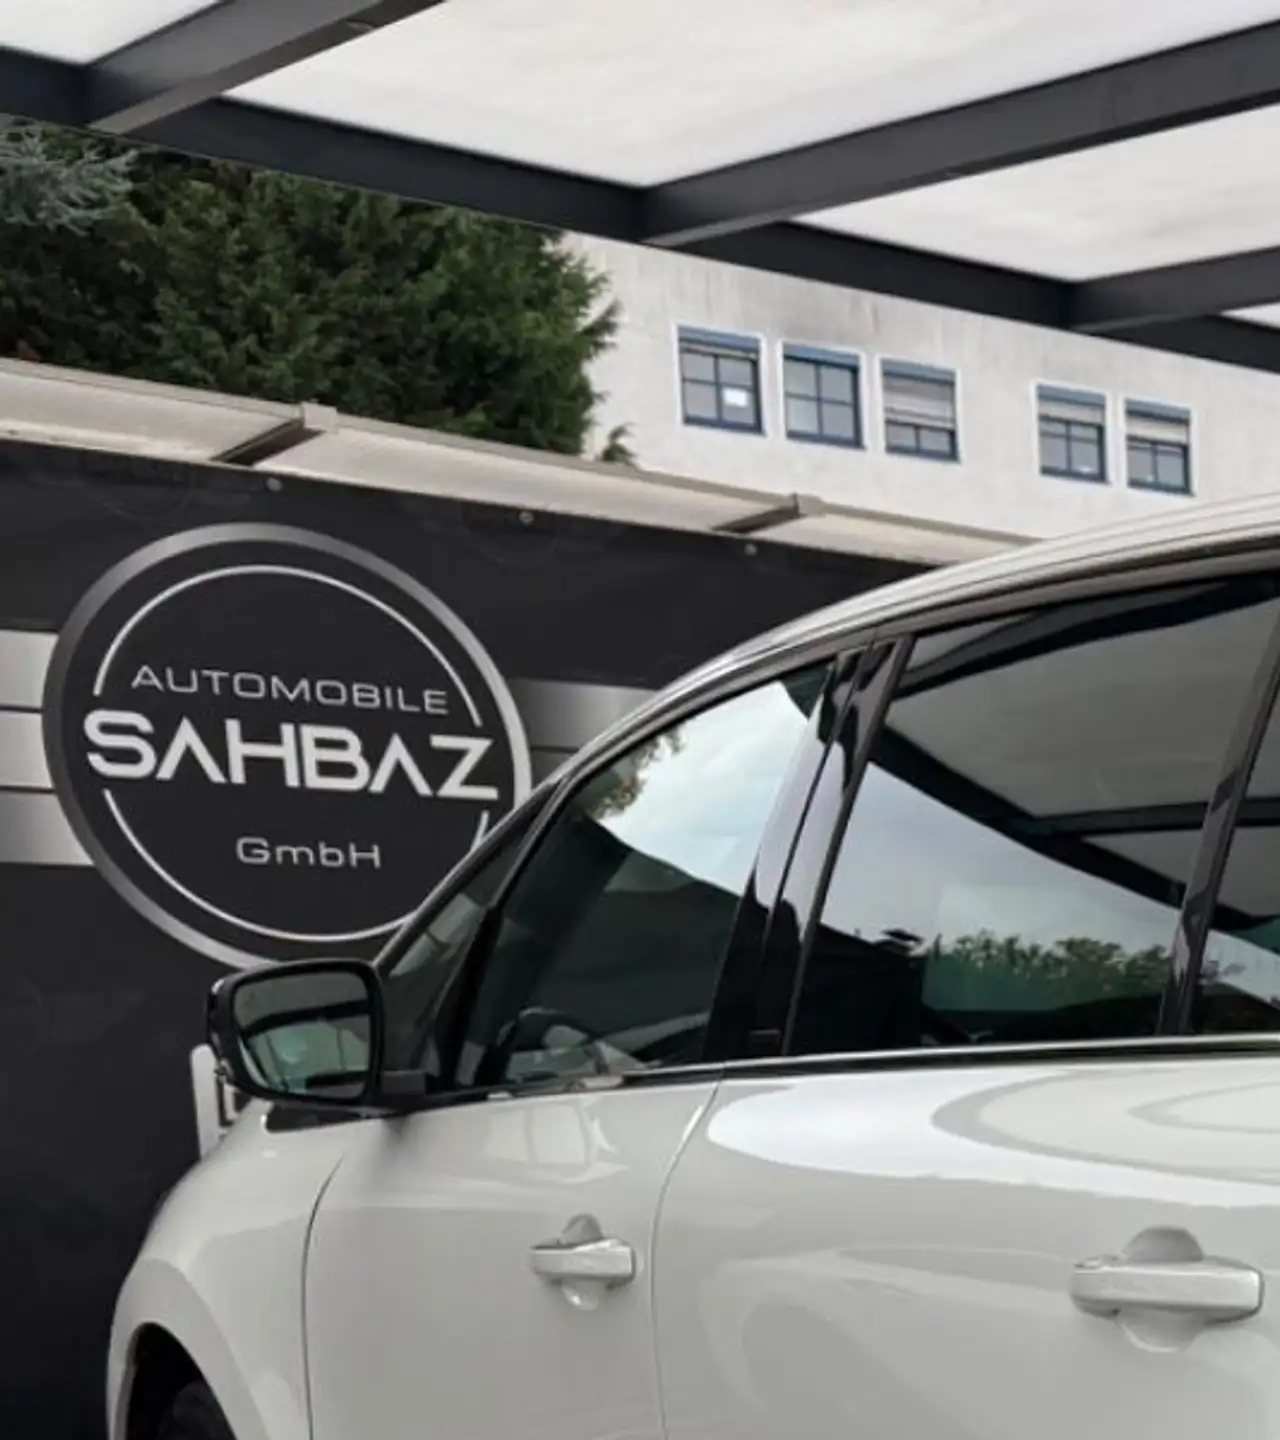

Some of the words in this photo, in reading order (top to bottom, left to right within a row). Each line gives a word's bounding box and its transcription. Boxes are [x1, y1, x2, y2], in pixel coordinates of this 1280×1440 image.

[131, 664, 449, 715] AUTOMOBILE
[82, 708, 499, 801] SAHBAZ
[235, 836, 382, 869] GmbH
